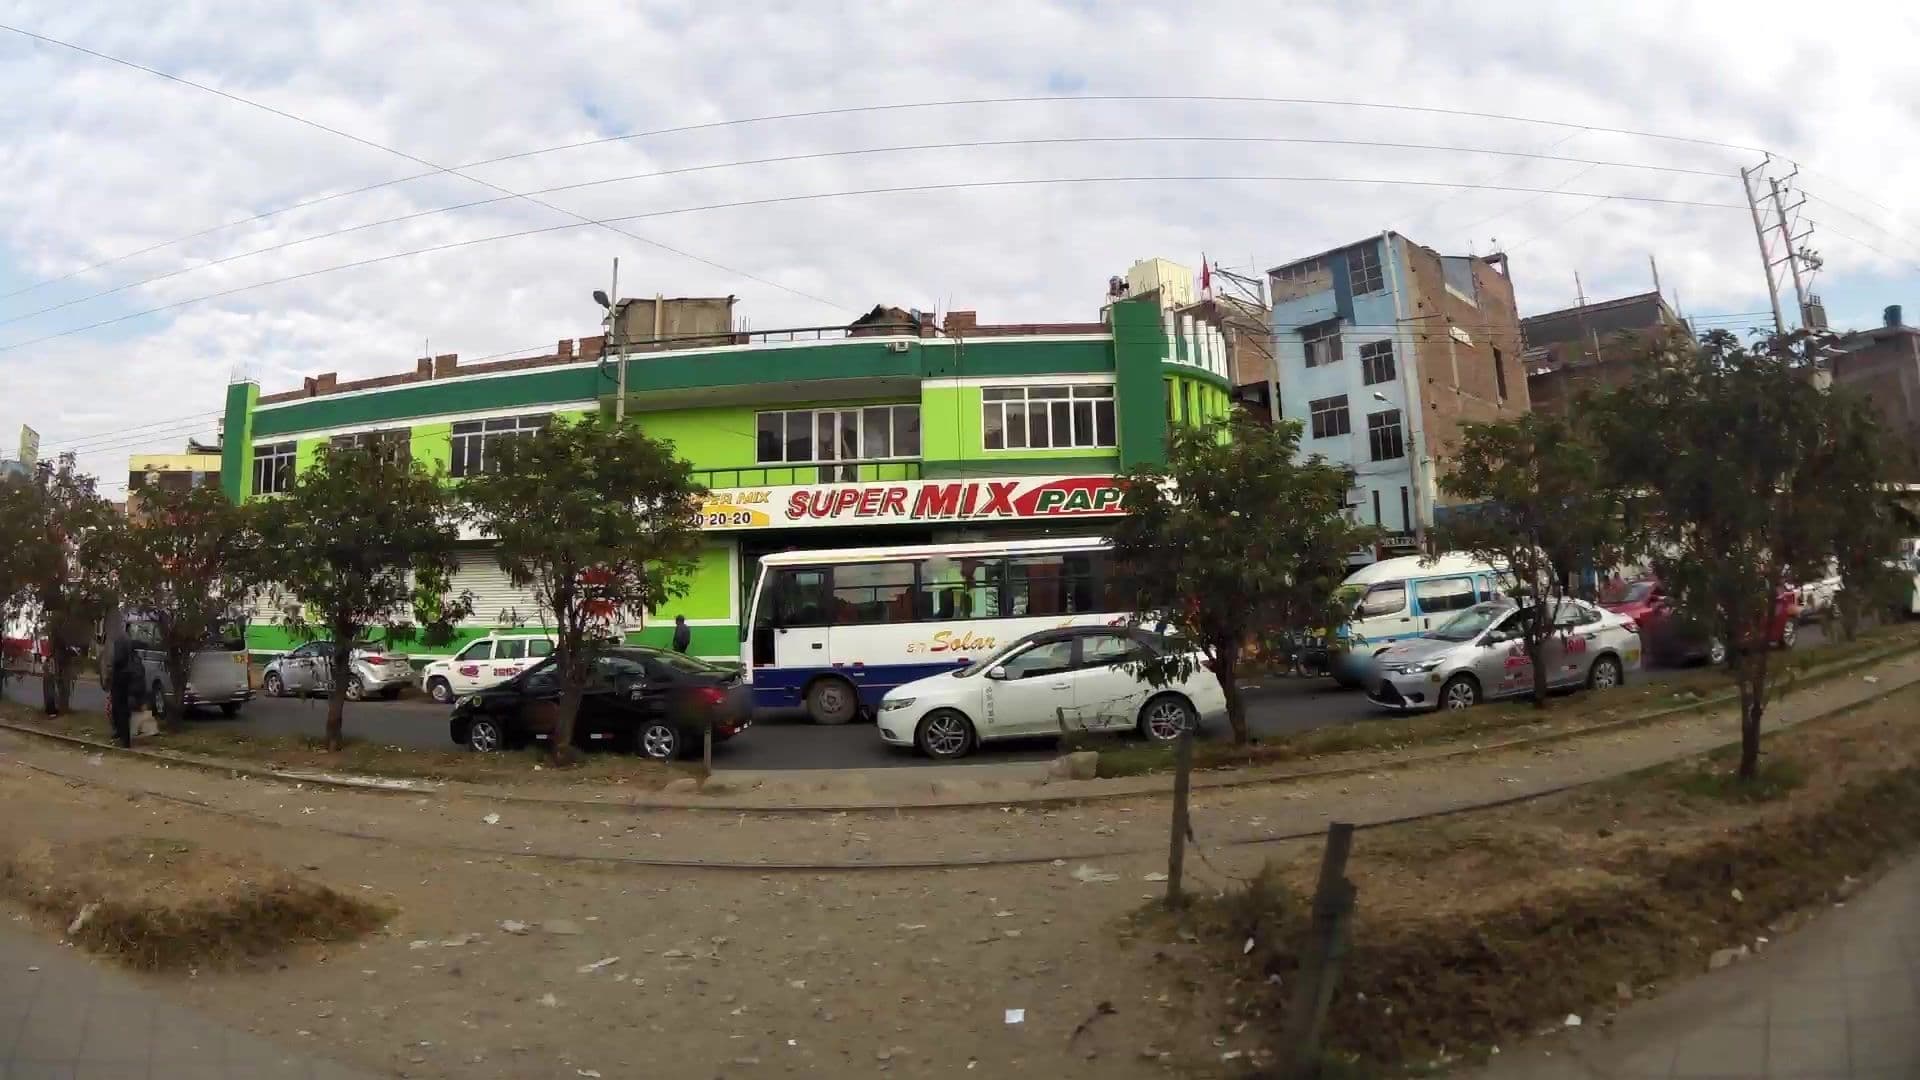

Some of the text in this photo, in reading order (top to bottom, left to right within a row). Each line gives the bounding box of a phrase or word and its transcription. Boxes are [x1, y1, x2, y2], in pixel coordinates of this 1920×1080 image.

[736, 490, 773, 505] MIX
[785, 481, 1128, 520] SUPER MIX PAP
[930, 630, 996, 653] Solar
